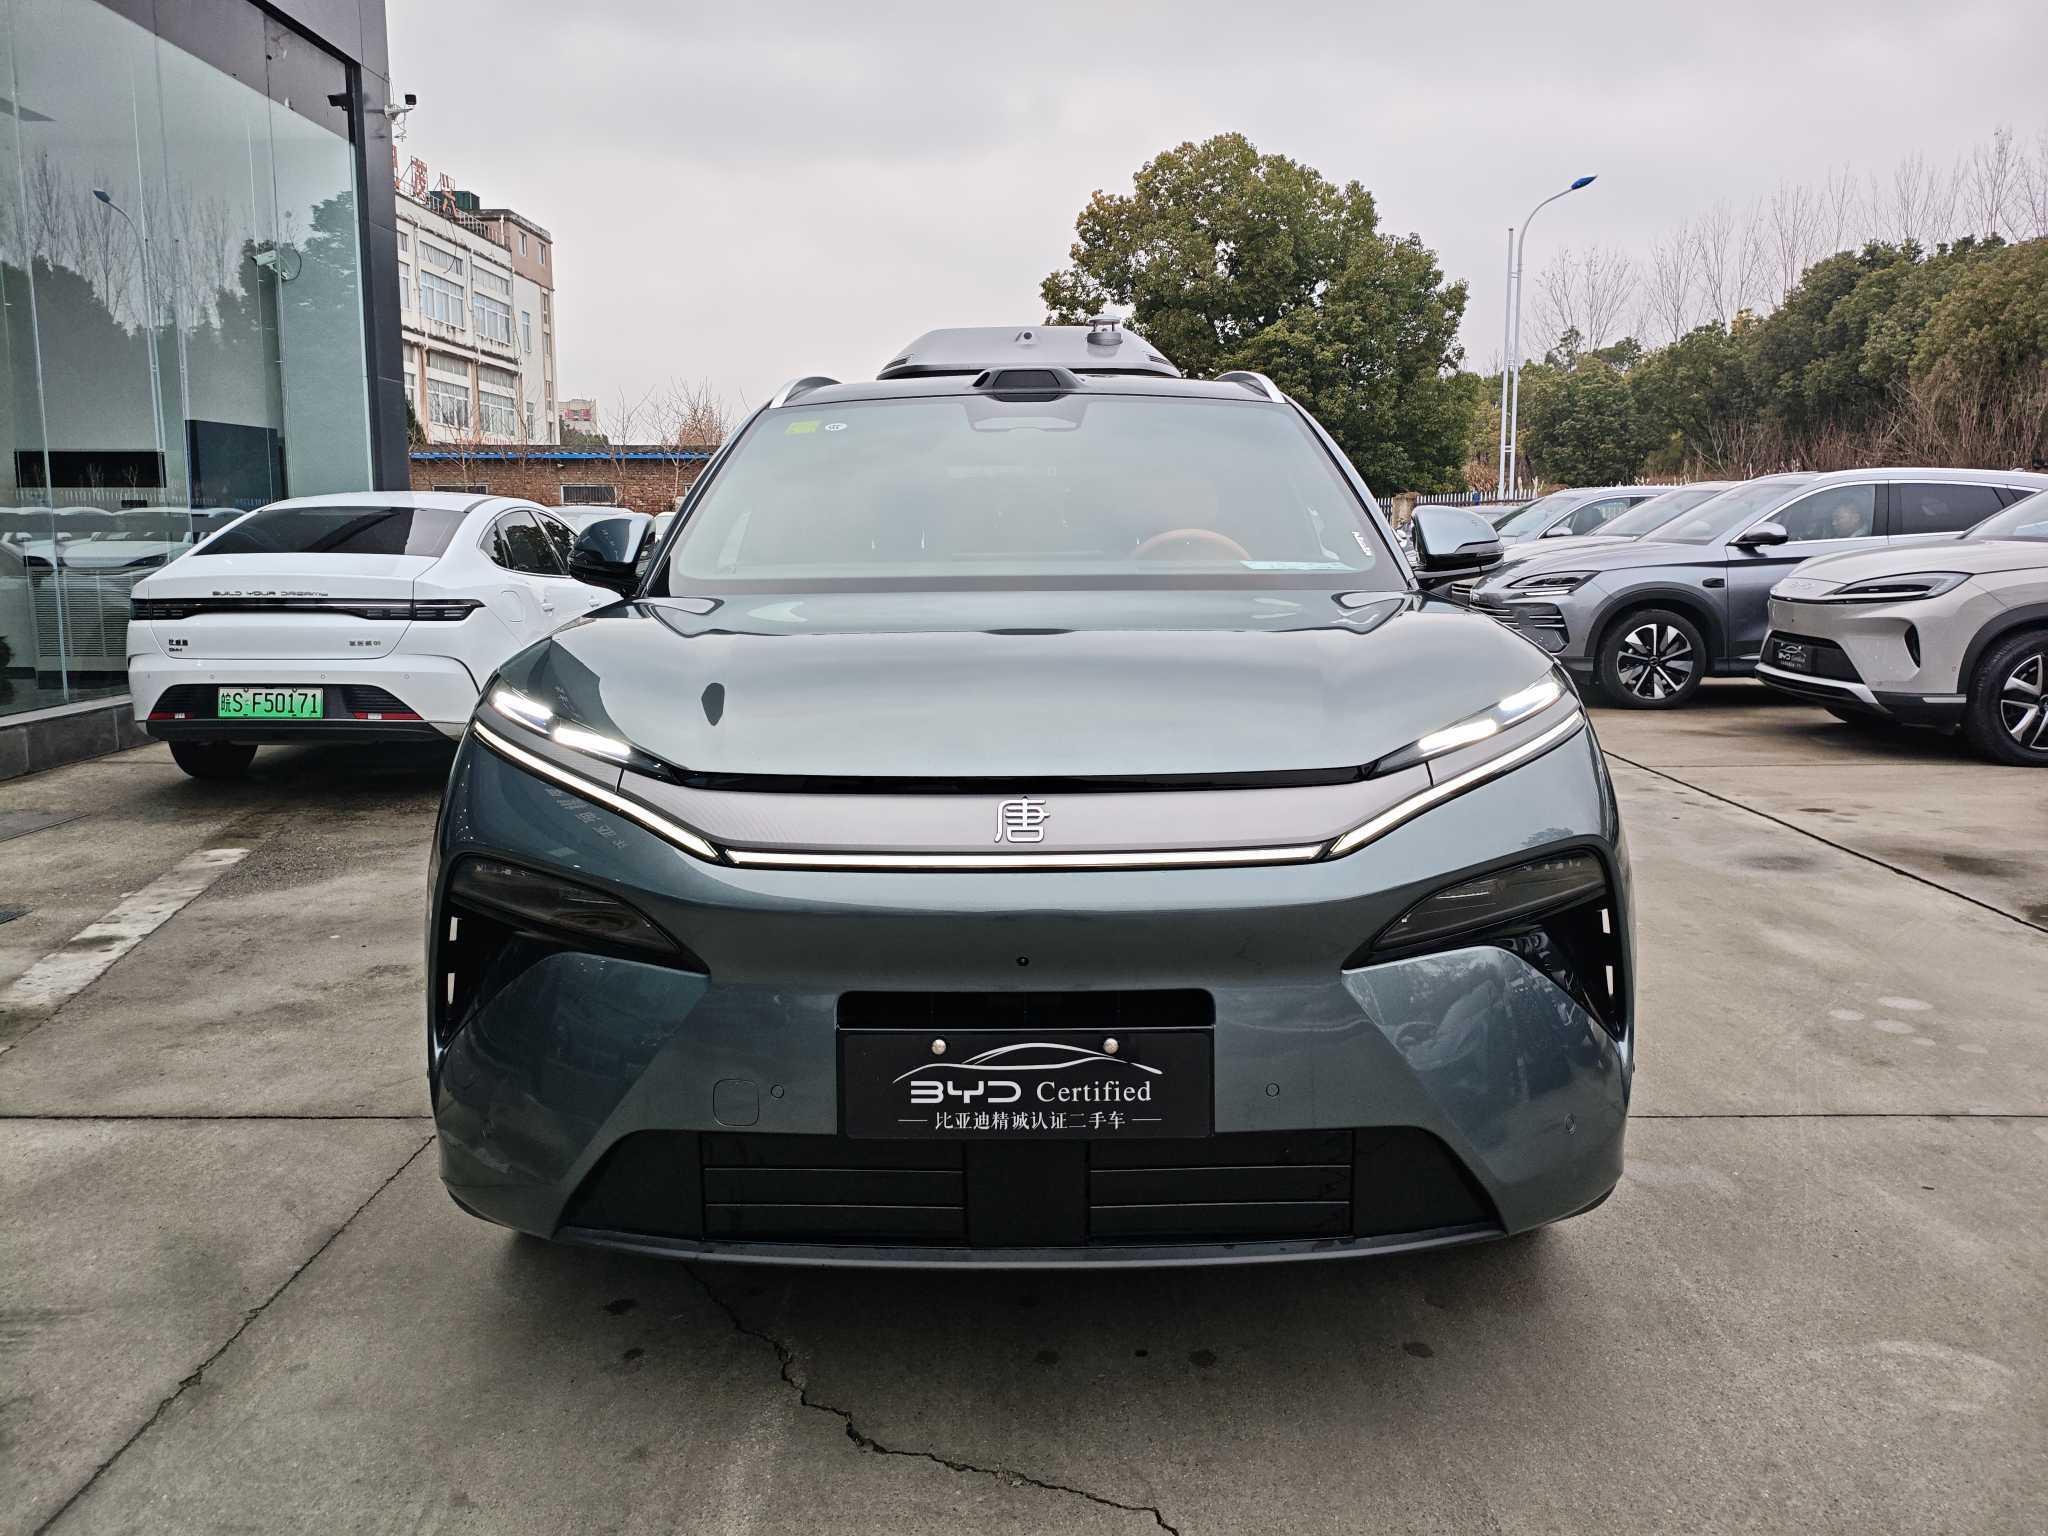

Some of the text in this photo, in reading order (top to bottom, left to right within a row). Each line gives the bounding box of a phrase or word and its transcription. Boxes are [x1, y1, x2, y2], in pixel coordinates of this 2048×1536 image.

[994, 796, 1051, 843] 唐
[910, 1080, 1152, 1104] BYD Certified
[934, 1111, 1126, 1130] 比亚迪精诚认证二手车
